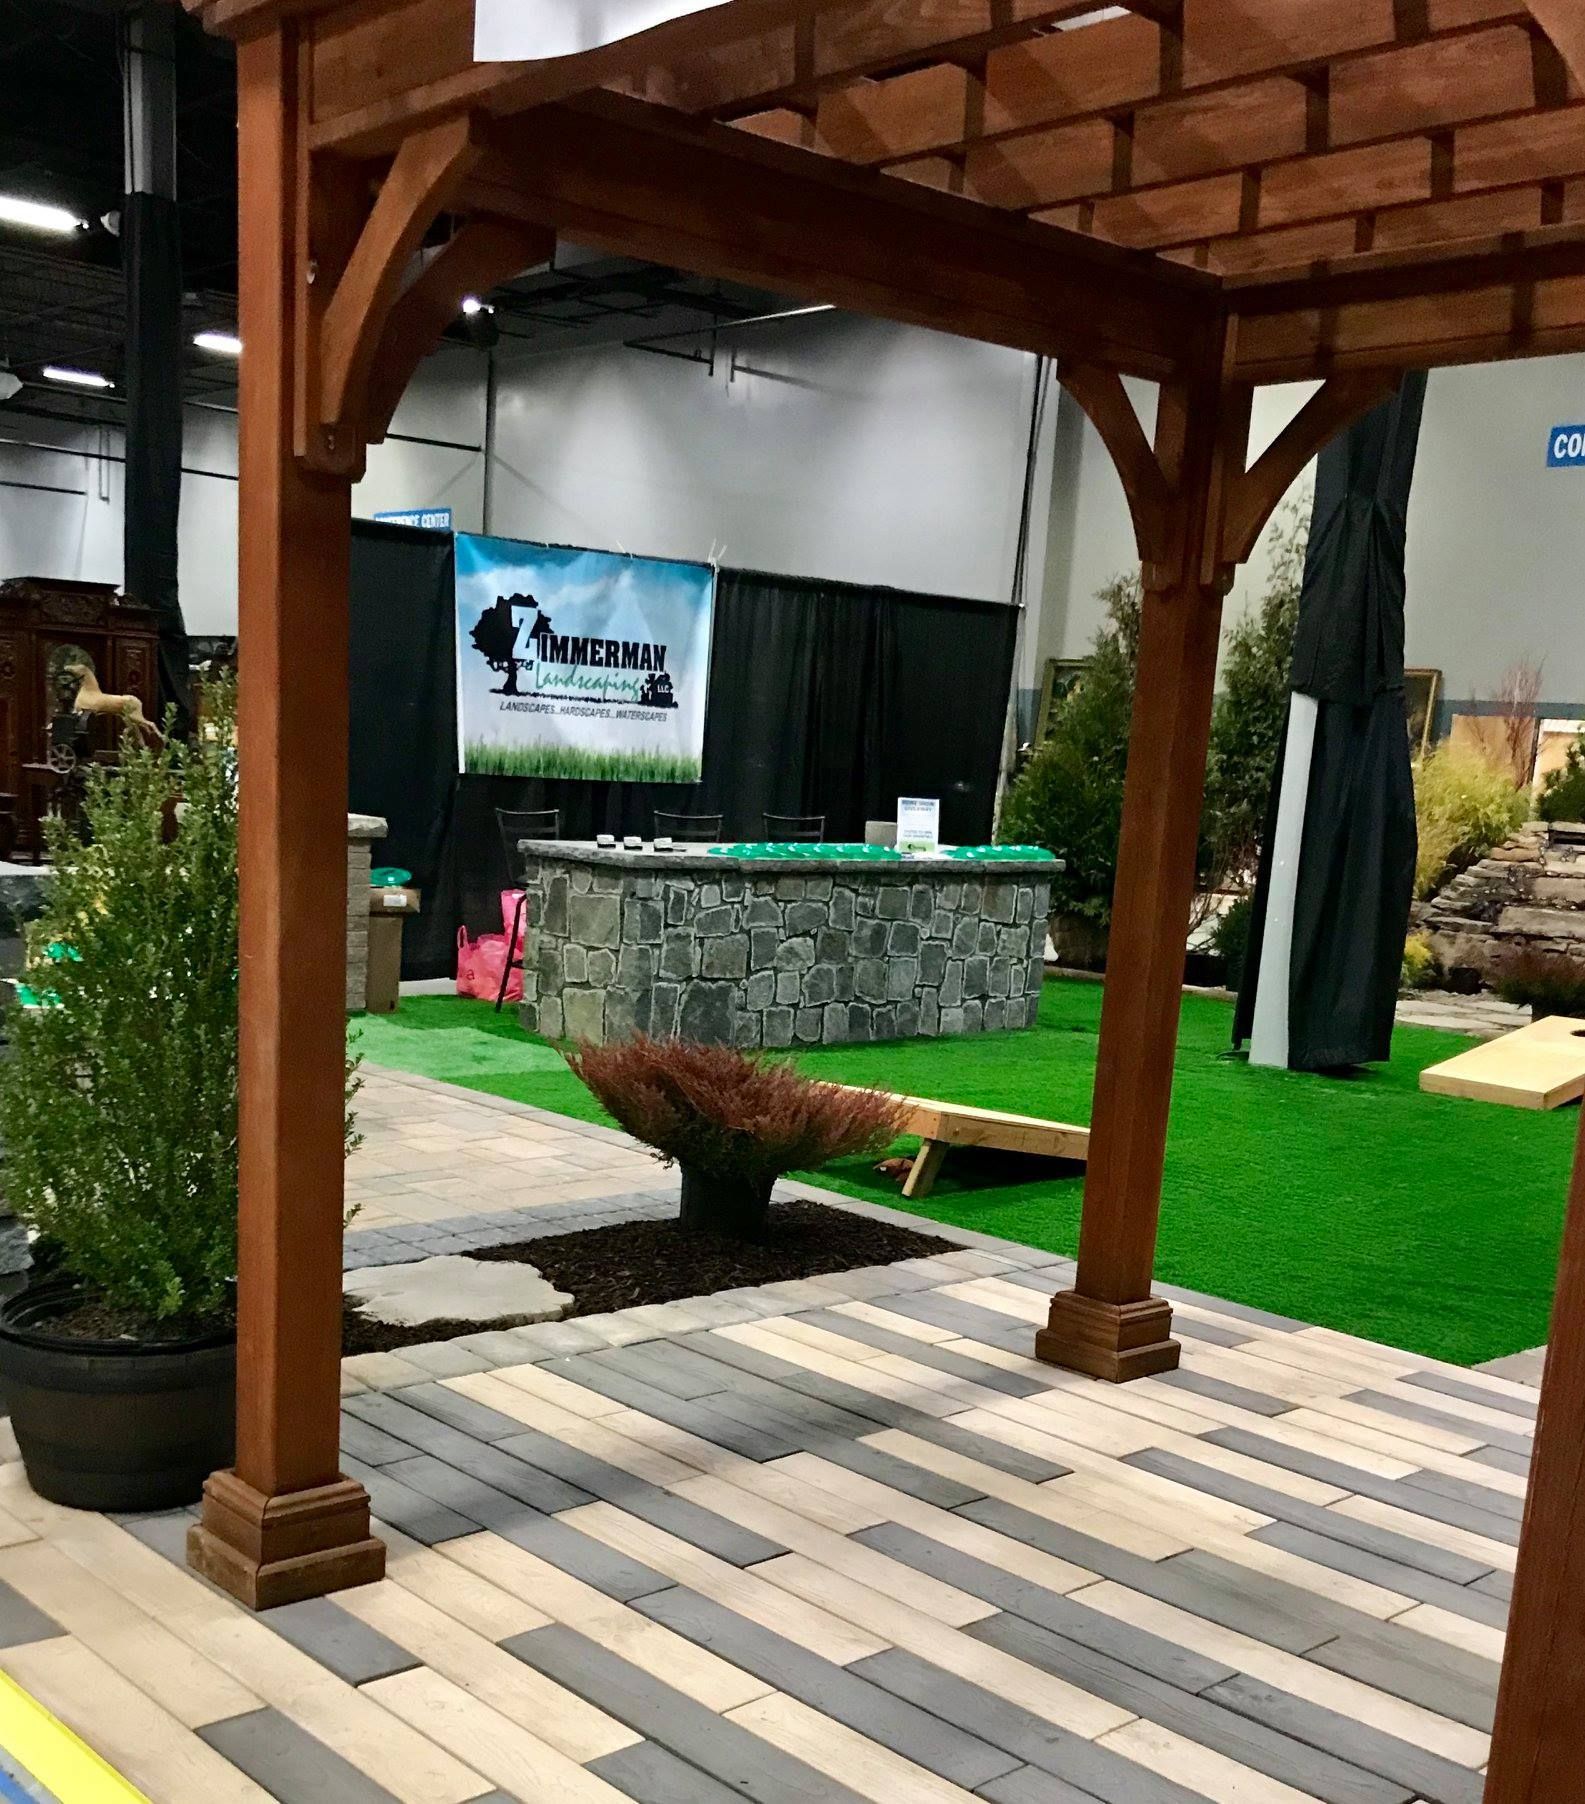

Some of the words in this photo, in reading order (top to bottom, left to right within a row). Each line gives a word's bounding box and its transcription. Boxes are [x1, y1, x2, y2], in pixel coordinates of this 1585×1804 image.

[511, 605, 667, 671] ZIMMERMAN
[536, 662, 640, 703] Landscaping
[657, 684, 670, 694] LLC
